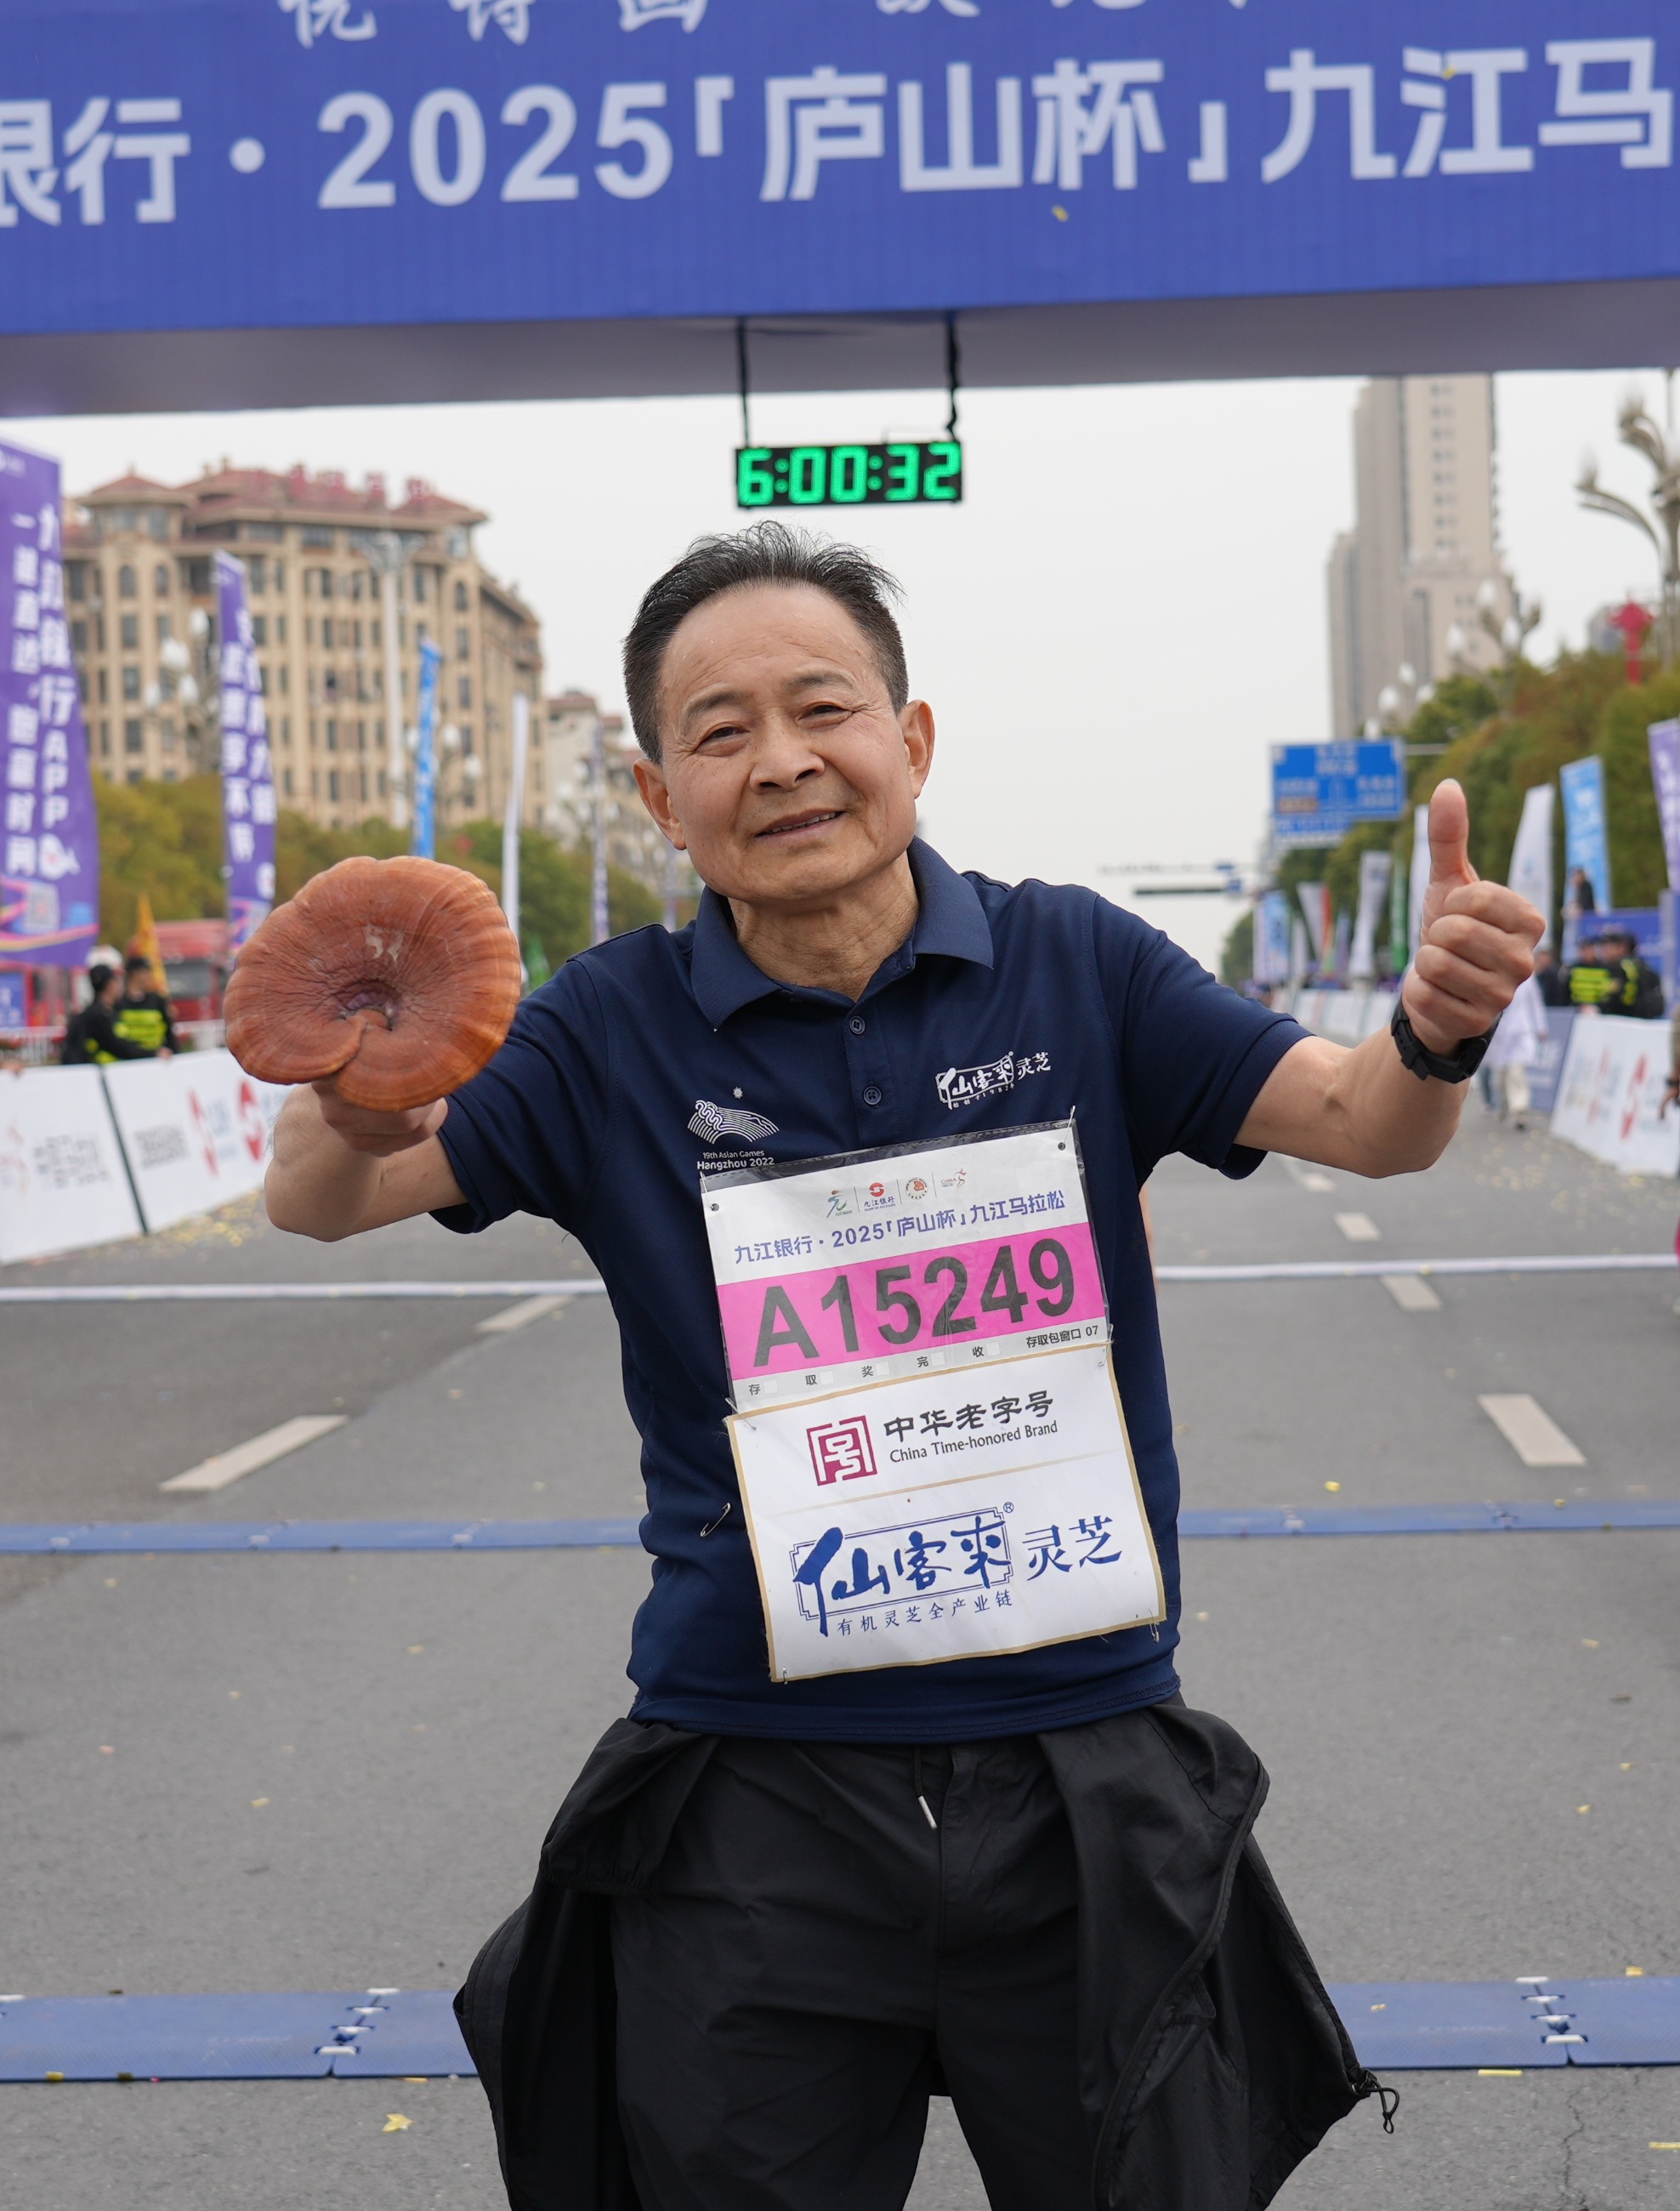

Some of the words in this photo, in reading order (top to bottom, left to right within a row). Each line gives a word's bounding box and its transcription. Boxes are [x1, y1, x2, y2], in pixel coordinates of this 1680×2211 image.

[739, 442, 961, 505] 6:00:32
[1016, 1052, 1051, 1080] 灵芝
[697, 1159, 747, 1171] Hangzhou
[749, 1157, 775, 1167] 2022
[739, 1150, 765, 1158] Games
[753, 1238, 1075, 1367] A15249
[748, 1383, 761, 1395] 存
[805, 1374, 817, 1386] 取
[861, 1366, 873, 1378] 奖
[917, 1356, 928, 1367] 完
[972, 1346, 985, 1357] 收
[1025, 1327, 1081, 1349] 存取包窗口
[1086, 1326, 1099, 1338] 07
[883, 1390, 1053, 1442] 中华老字号
[889, 1447, 928, 1463] China
[930, 1429, 1021, 1455] Time-honored
[1025, 1420, 1059, 1438] Brand
[1022, 1515, 1122, 1581] 灵芝
[837, 1589, 1013, 1636] 有机灵芝全产业链
